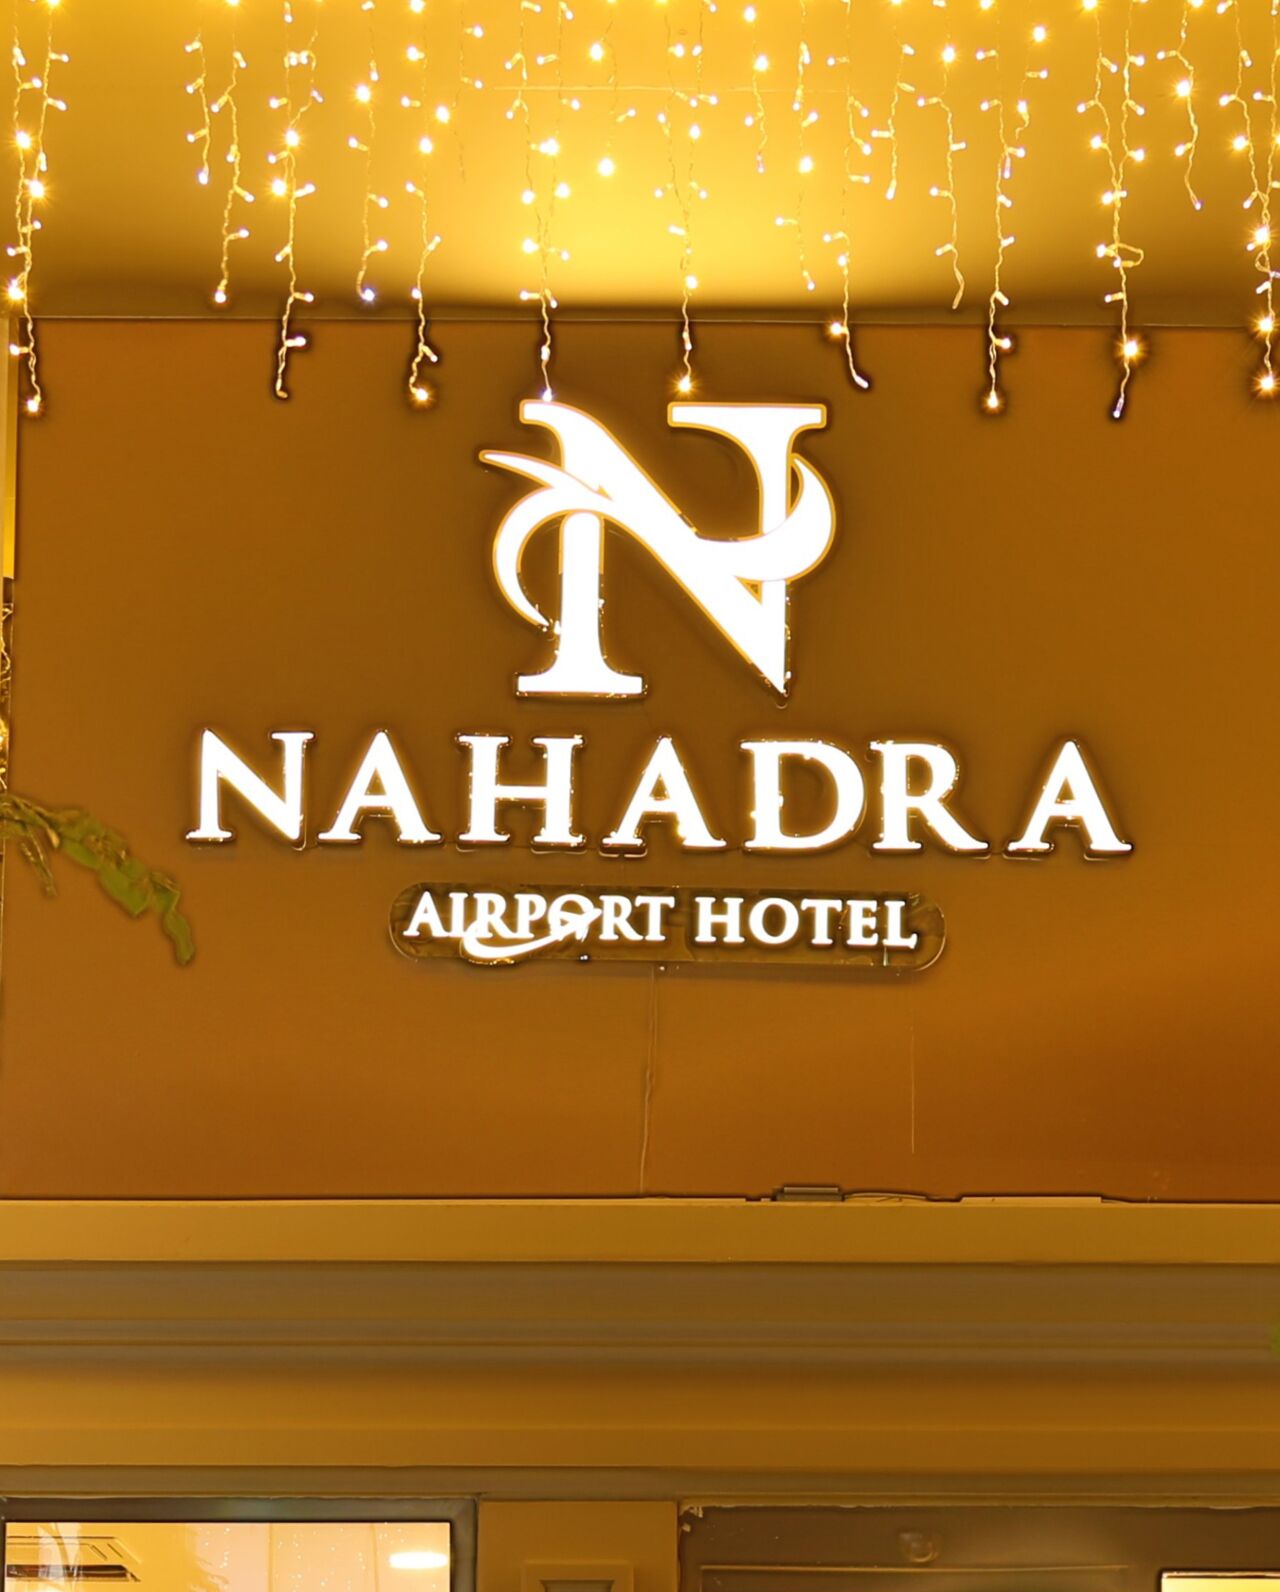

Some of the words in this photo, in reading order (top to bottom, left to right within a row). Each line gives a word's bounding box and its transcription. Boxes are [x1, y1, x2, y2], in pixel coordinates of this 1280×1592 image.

[479, 399, 836, 697] N
[186, 728, 1133, 854] NAHADRA
[402, 890, 676, 959] AIRPORT
[694, 896, 918, 949] HOTEL
